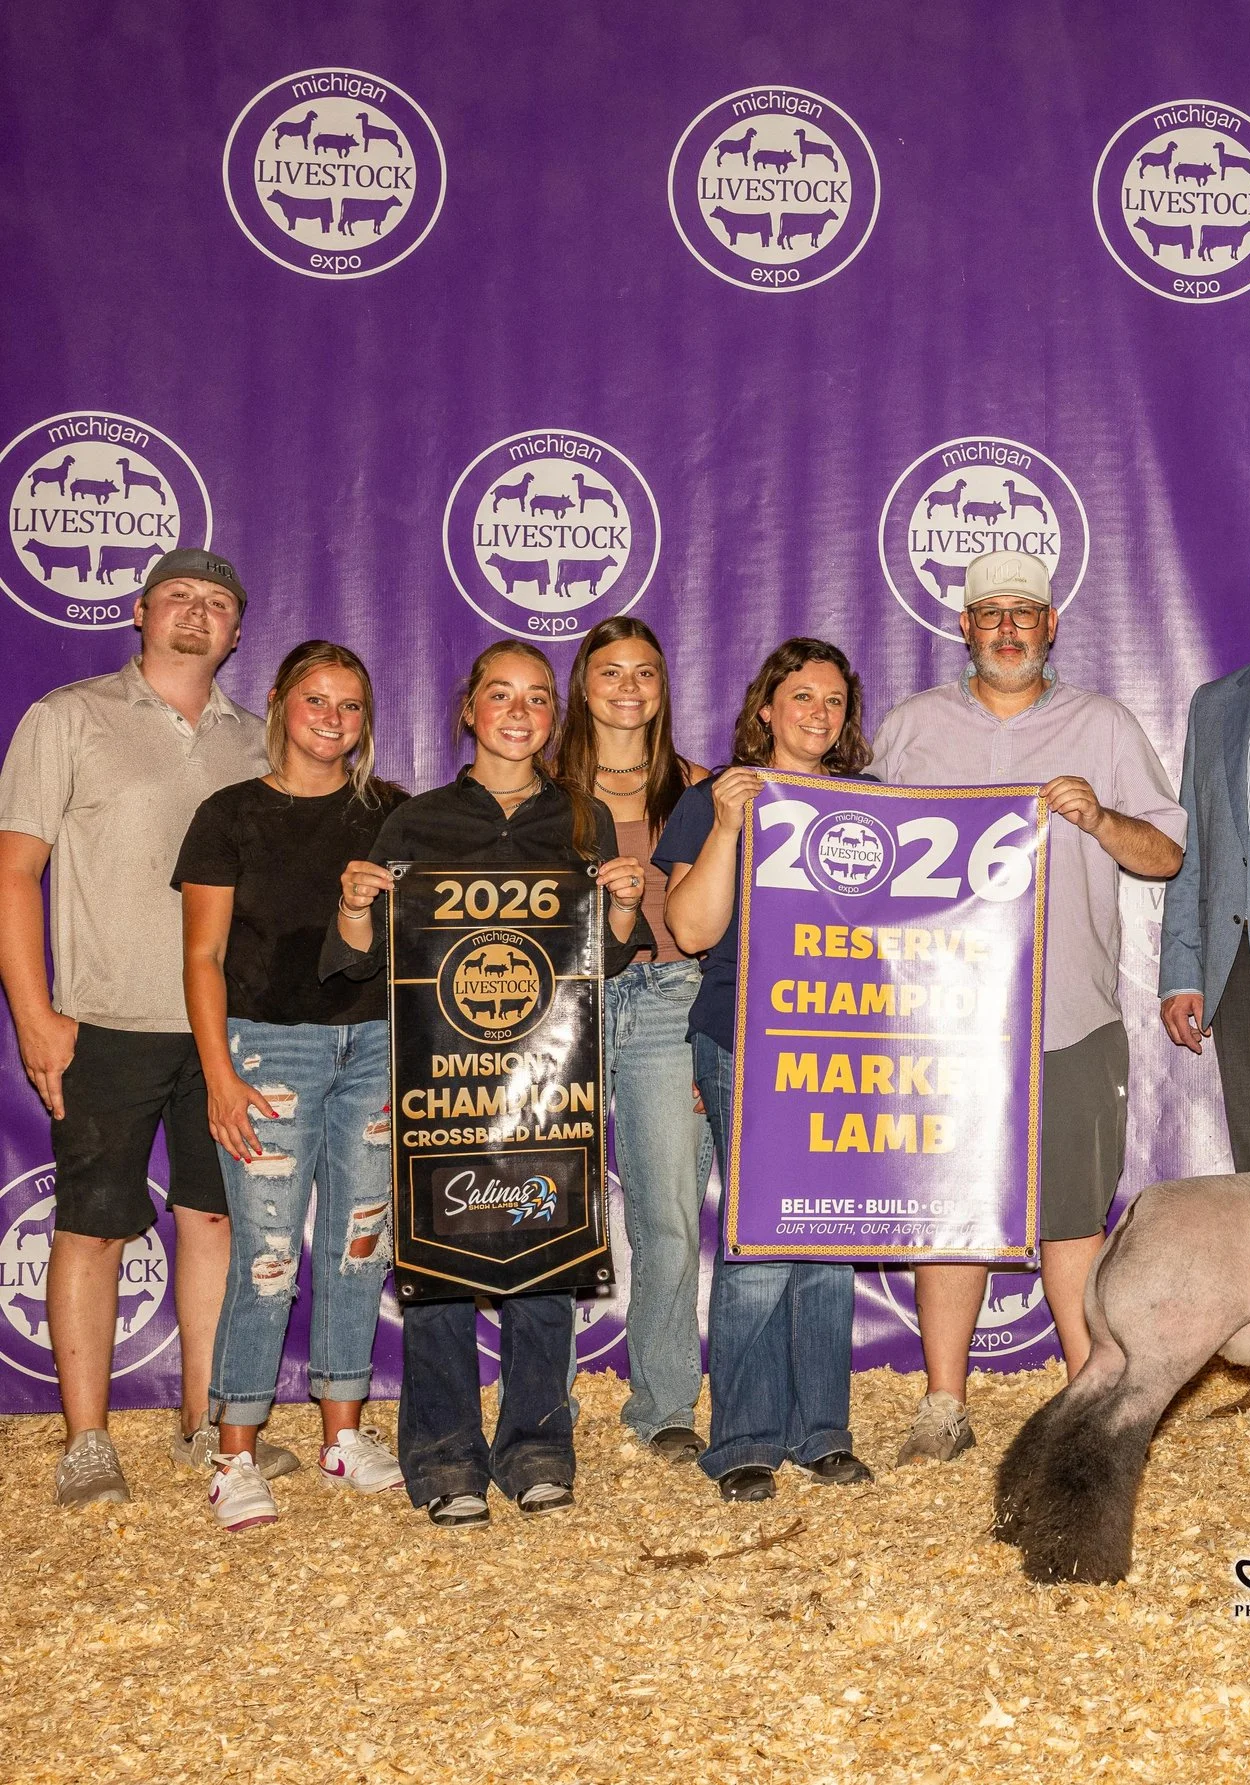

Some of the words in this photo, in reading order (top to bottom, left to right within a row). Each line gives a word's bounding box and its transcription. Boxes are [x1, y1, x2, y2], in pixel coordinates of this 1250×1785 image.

[292, 74, 386, 102] michigan
[733, 92, 822, 118] michigan
[1154, 105, 1241, 132] michigan
[258, 160, 412, 189] LIVESTOCK
[701, 177, 847, 203] LIVESTOCK
[311, 254, 361, 273] expo
[751, 268, 799, 287] expo
[1174, 279, 1220, 297] expo
[49, 417, 149, 448] michigan
[509, 435, 601, 462] michigan
[942, 443, 1031, 469] michigan
[13, 508, 176, 537] LIVESTOCK
[477, 524, 627, 549] LIVESTOCK
[912, 530, 1057, 555] LIVESTOCK
[67, 605, 120, 624] expo
[528, 617, 577, 635] expo
[835, 813, 874, 826] michigan
[820, 845, 882, 862] LIVESTOCK
[434, 879, 560, 919] 2026
[838, 885, 859, 893] expo
[472, 931, 523, 946] michigan
[794, 923, 990, 961] RESERVE
[455, 980, 537, 994] LIVESTOCK
[770, 979, 1007, 1020] CHAMPIO
[484, 1030, 511, 1040] expo
[432, 1052, 543, 1078] DIVISION
[775, 1053, 1000, 1095] MARKE
[402, 1082, 594, 1119] CHAMPION
[403, 1125, 530, 1147] CROSSBRED
[535, 1122, 594, 1141] LAMB
[809, 1113, 955, 1154] LAMB
[445, 1171, 534, 1216] Salinas
[781, 1199, 855, 1214] BELIEVE
[866, 1199, 918, 1214] BUILD
[776, 1223, 806, 1235] OUR
[808, 1223, 856, 1237] YOUTH,
[860, 1223, 890, 1235] OUR
[0, 1259, 164, 1287] LIVCK
